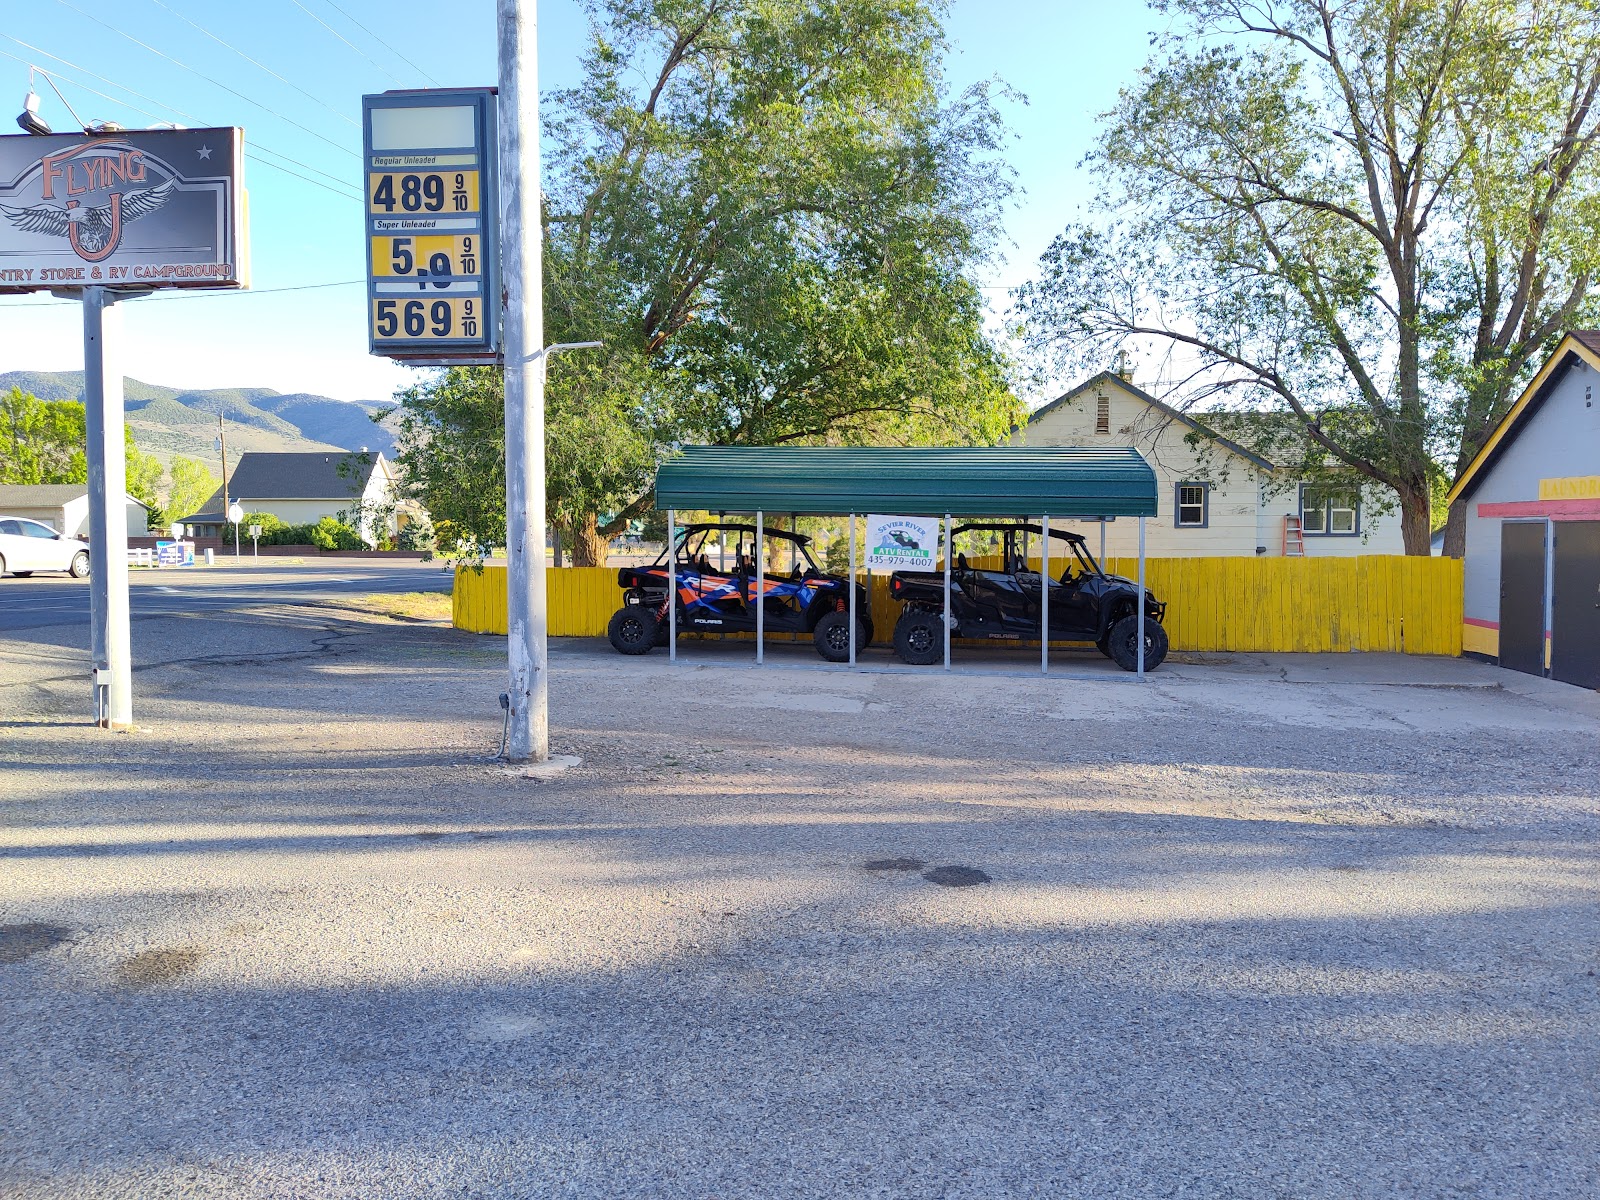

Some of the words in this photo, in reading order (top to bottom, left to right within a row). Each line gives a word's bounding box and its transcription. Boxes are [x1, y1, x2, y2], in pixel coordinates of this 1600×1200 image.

[41, 138, 146, 200] FLYING
[374, 157, 402, 166] Regular
[404, 156, 436, 165] Unleaded
[373, 174, 445, 212] 489
[377, 220, 400, 230] Super
[401, 220, 436, 229] Unleaded
[40, 267, 86, 281] STORE
[90, 265, 103, 280] &
[109, 266, 129, 279] RV
[133, 263, 232, 279] CAMPGROUND
[377, 300, 452, 337] 569
[1542, 479, 1600, 497] LAUNDR
[877, 521, 904, 534] SEVIER
[905, 521, 926, 537] RIVER
[867, 555, 933, 567] 435-979-4007
[878, 547, 896, 556] ATV
[896, 549, 925, 558] RENTAL
